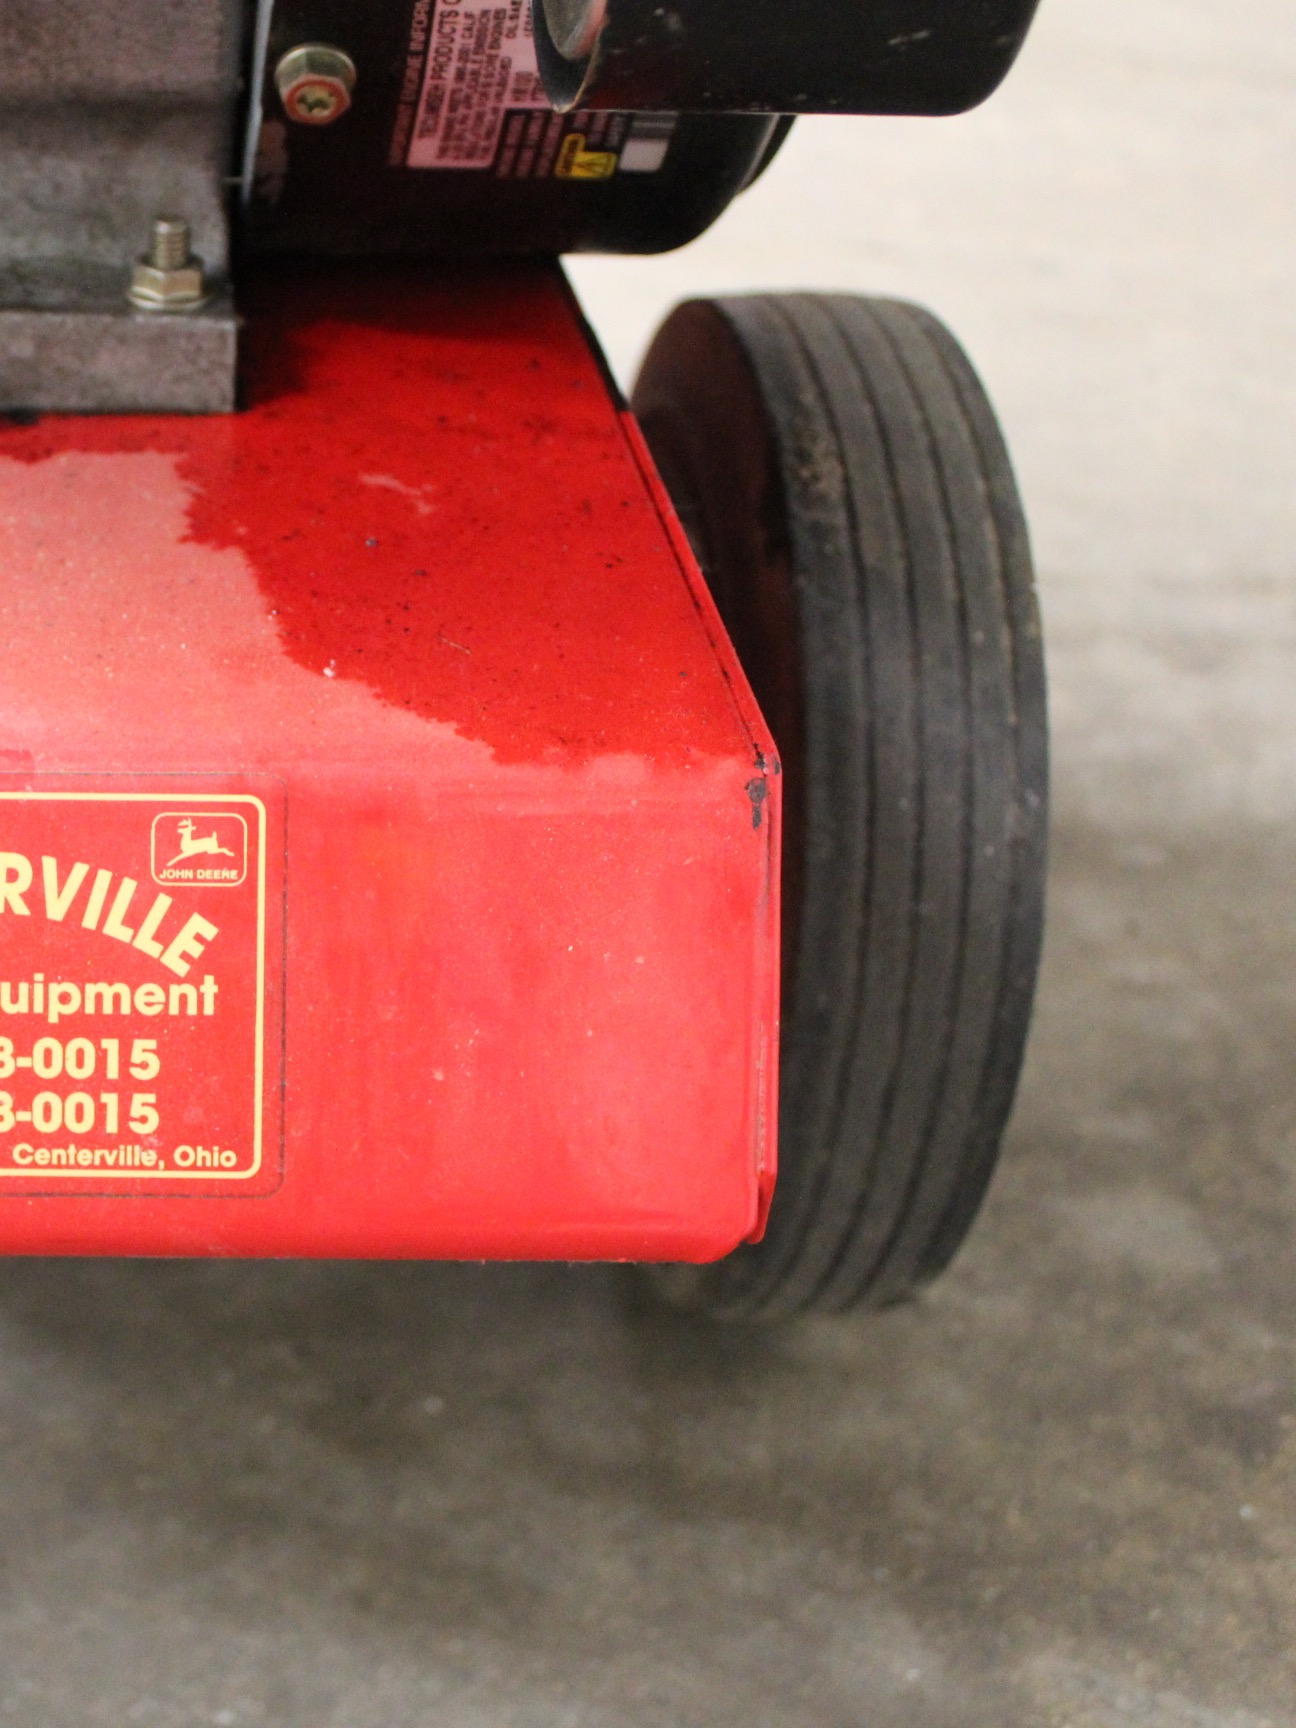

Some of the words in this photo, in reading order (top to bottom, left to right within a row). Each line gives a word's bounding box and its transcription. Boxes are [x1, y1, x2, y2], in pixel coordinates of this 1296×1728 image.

[429, 10, 459, 80] PRODUCTS
[159, 869, 193, 879] JOHN
[197, 868, 238, 880] DEERE
[13, 1143, 165, 1170] Centerville,
[174, 1144, 237, 1168] Ohio
